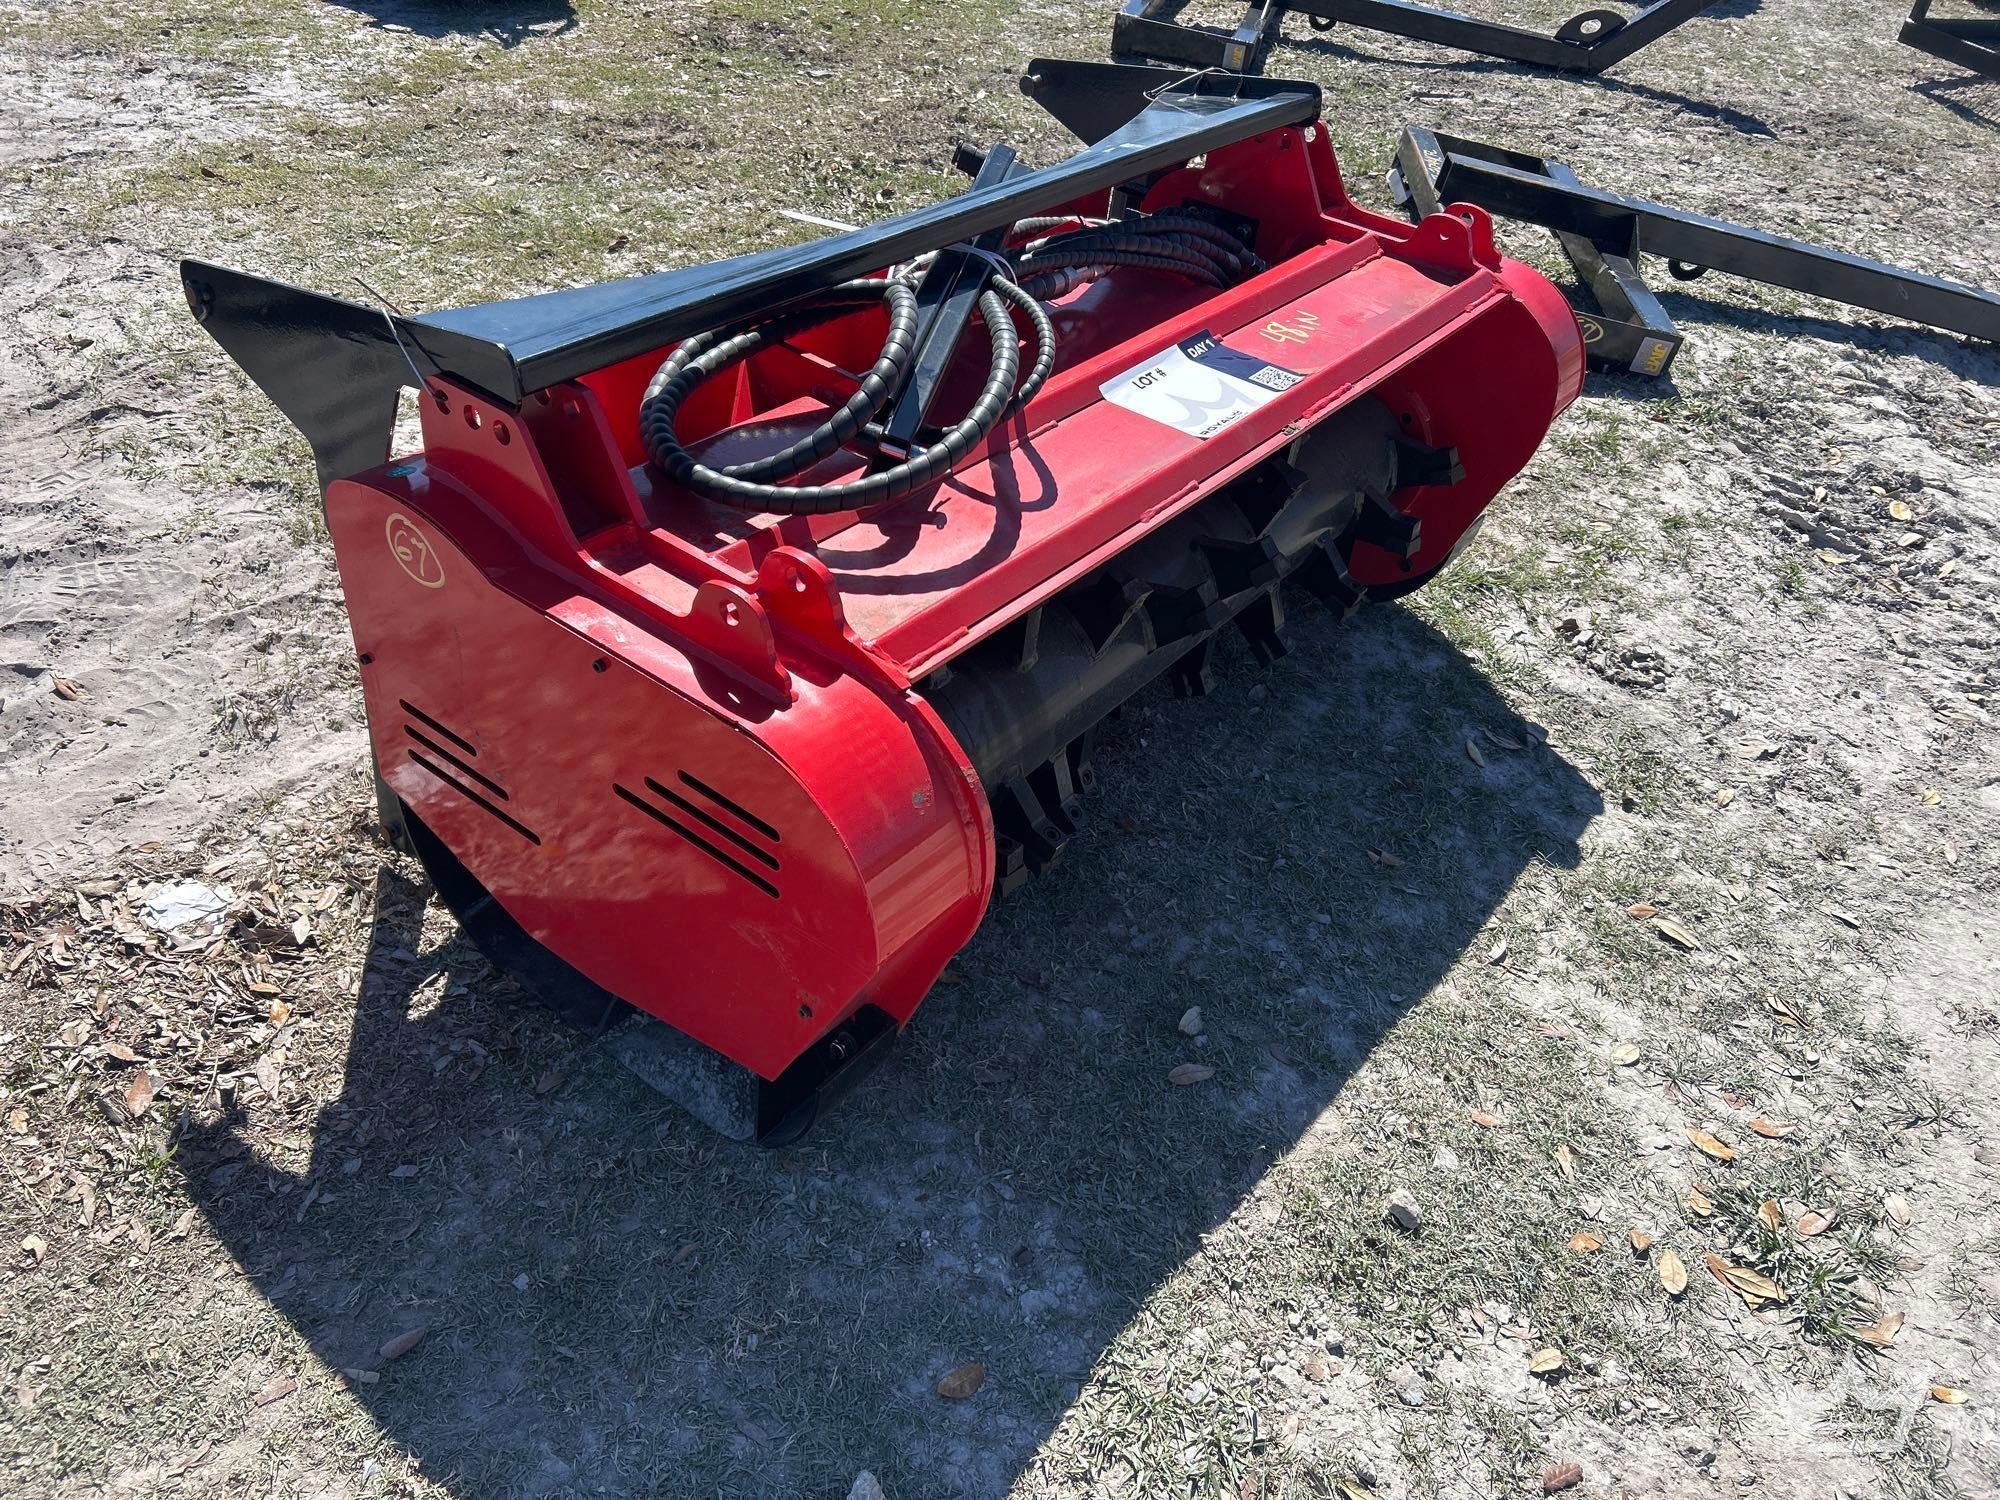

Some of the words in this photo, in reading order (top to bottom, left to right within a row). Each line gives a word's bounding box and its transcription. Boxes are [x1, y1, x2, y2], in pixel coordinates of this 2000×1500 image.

[1187, 340, 1207, 358] DAY
[1205, 338, 1216, 349] 1
[1132, 371, 1159, 389] LOT
[1156, 367, 1168, 377] #
[394, 530, 426, 577] 67
